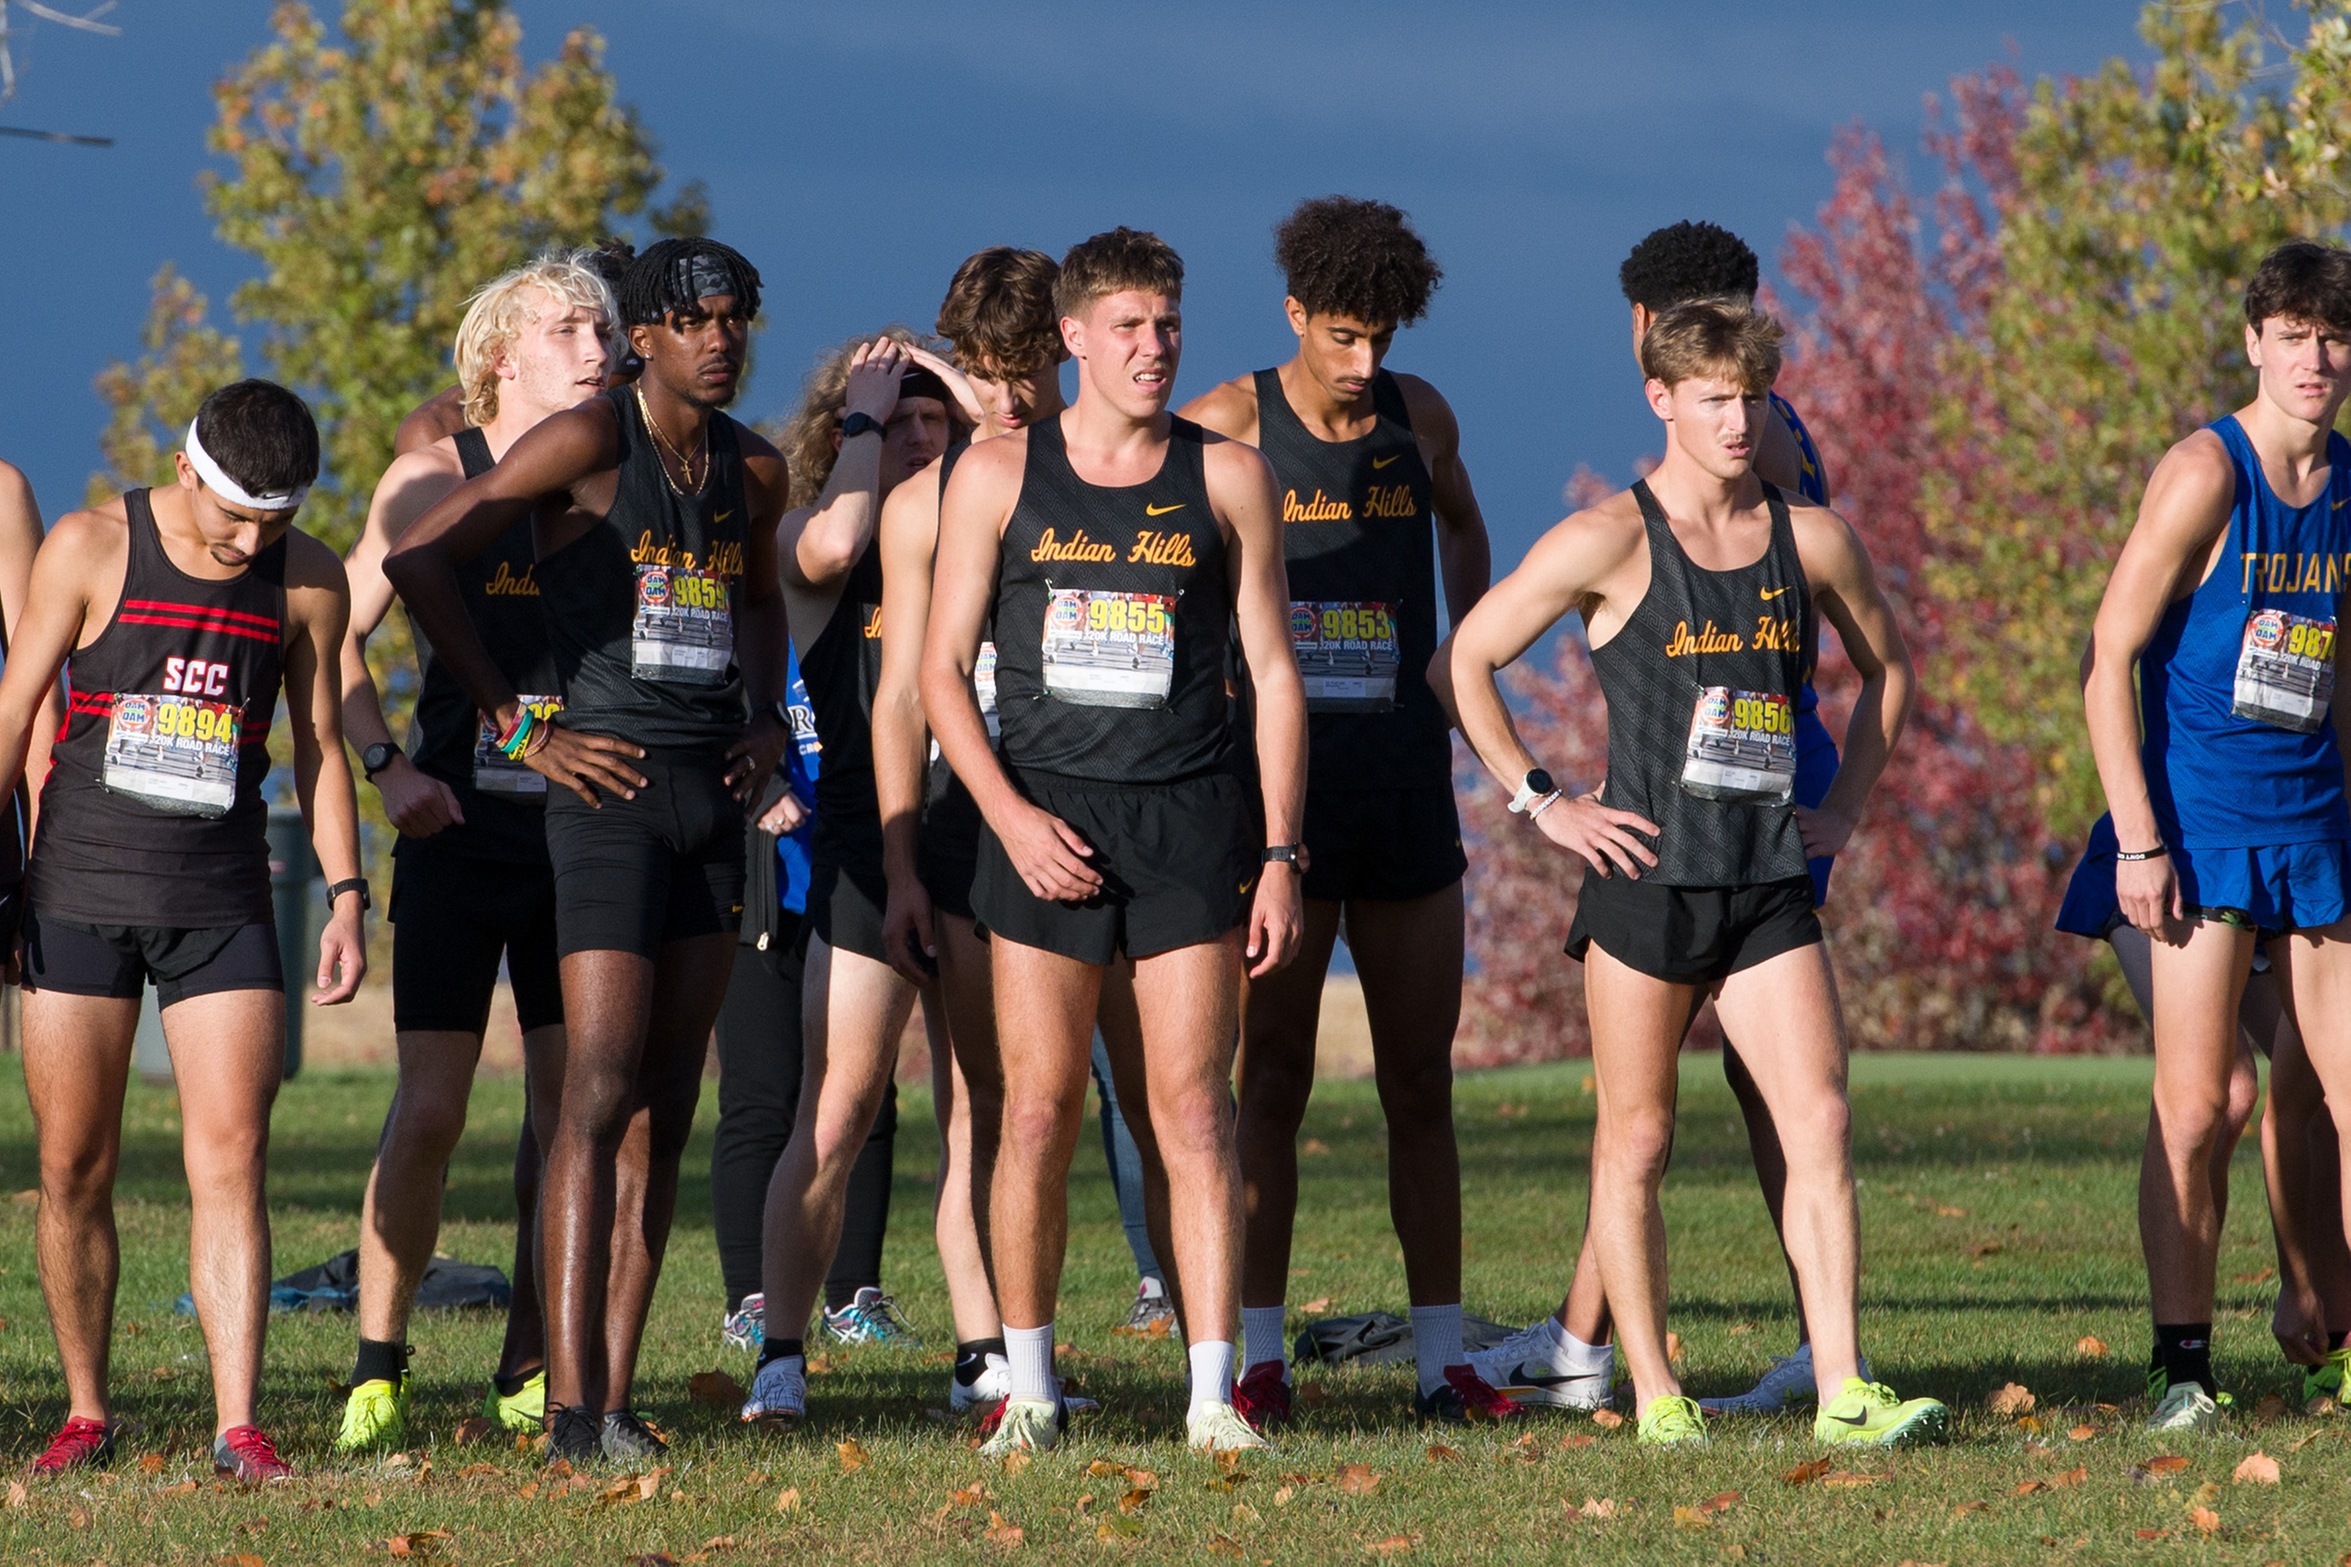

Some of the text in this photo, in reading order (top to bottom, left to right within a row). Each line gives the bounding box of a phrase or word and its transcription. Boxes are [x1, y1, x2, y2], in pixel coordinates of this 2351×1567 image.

[1283, 484, 1417, 522] Indian Hills
[630, 529, 744, 575] Indian Hills
[1031, 527, 1196, 566] Indian Hills
[485, 560, 541, 597] Indi
[674, 575, 726, 609] 9859
[673, 608, 690, 618] 20K
[691, 608, 711, 620] ROAD
[711, 611, 728, 622] RACE
[1089, 598, 1165, 633] 9855
[1322, 609, 1391, 640] 9853
[1089, 631, 1108, 642] 20K
[1109, 632, 1137, 644] ROAD
[1139, 633, 1165, 646] RACE
[1323, 640, 1342, 651] 20K
[1343, 640, 1368, 651] ROAD
[1370, 641, 1393, 651] RACE
[1666, 620, 1743, 657] Indian
[163, 656, 230, 697] SCC
[2281, 653, 2299, 667] 20K
[2299, 655, 2322, 671] ROAD
[158, 703, 232, 743] 9894
[1734, 697, 1792, 734] 9856
[155, 735, 175, 748] 20K
[176, 738, 203, 751] ROAD
[205, 742, 231, 756] RACE
[1731, 729, 1749, 742] 20K
[1749, 731, 1771, 743] ROAD
[1772, 734, 1792, 746] RACE
